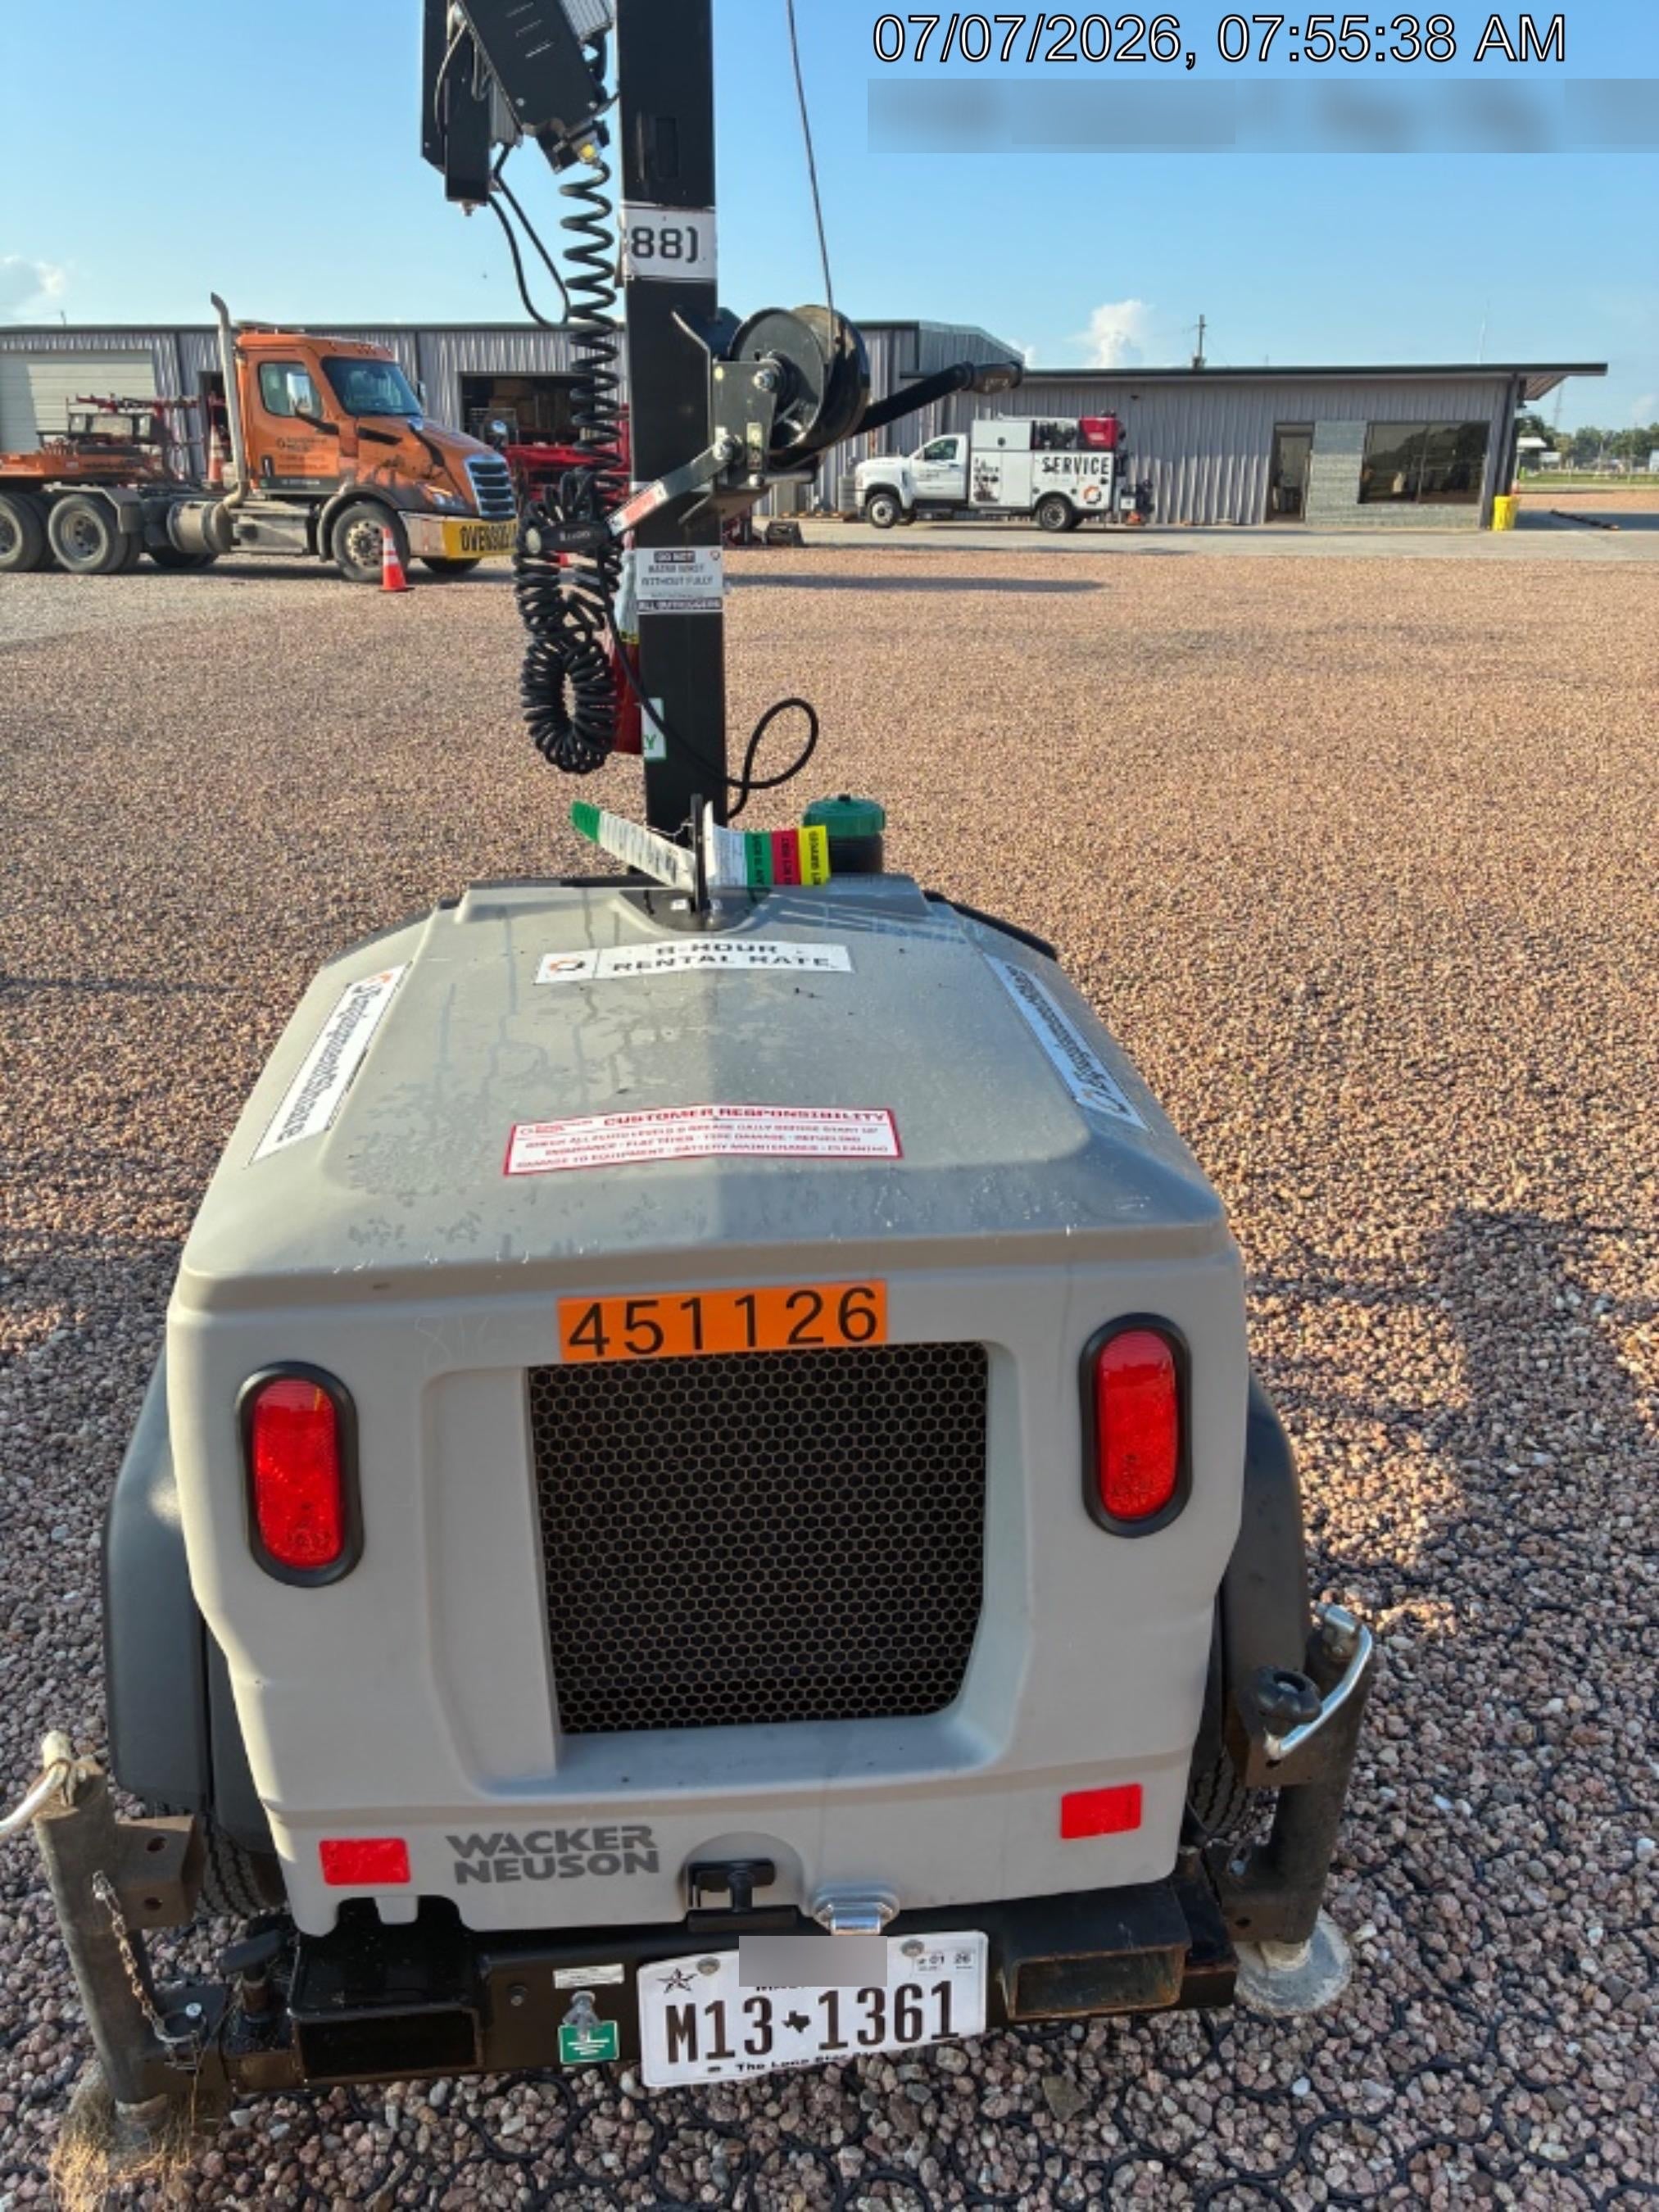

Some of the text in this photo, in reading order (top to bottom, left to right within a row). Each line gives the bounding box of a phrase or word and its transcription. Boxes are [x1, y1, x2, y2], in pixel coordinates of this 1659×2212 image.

[1042, 456, 1109, 475] SERVICE
[614, 954, 734, 972] RENTAL
[603, 1107, 885, 1126] CUSTOMER RESPONSIBILITY
[569, 1286, 878, 1357] 451126
[444, 1824, 659, 1860] WACKER
[454, 1850, 660, 1885] NEUSON
[666, 1979, 960, 2064] M13 1361
